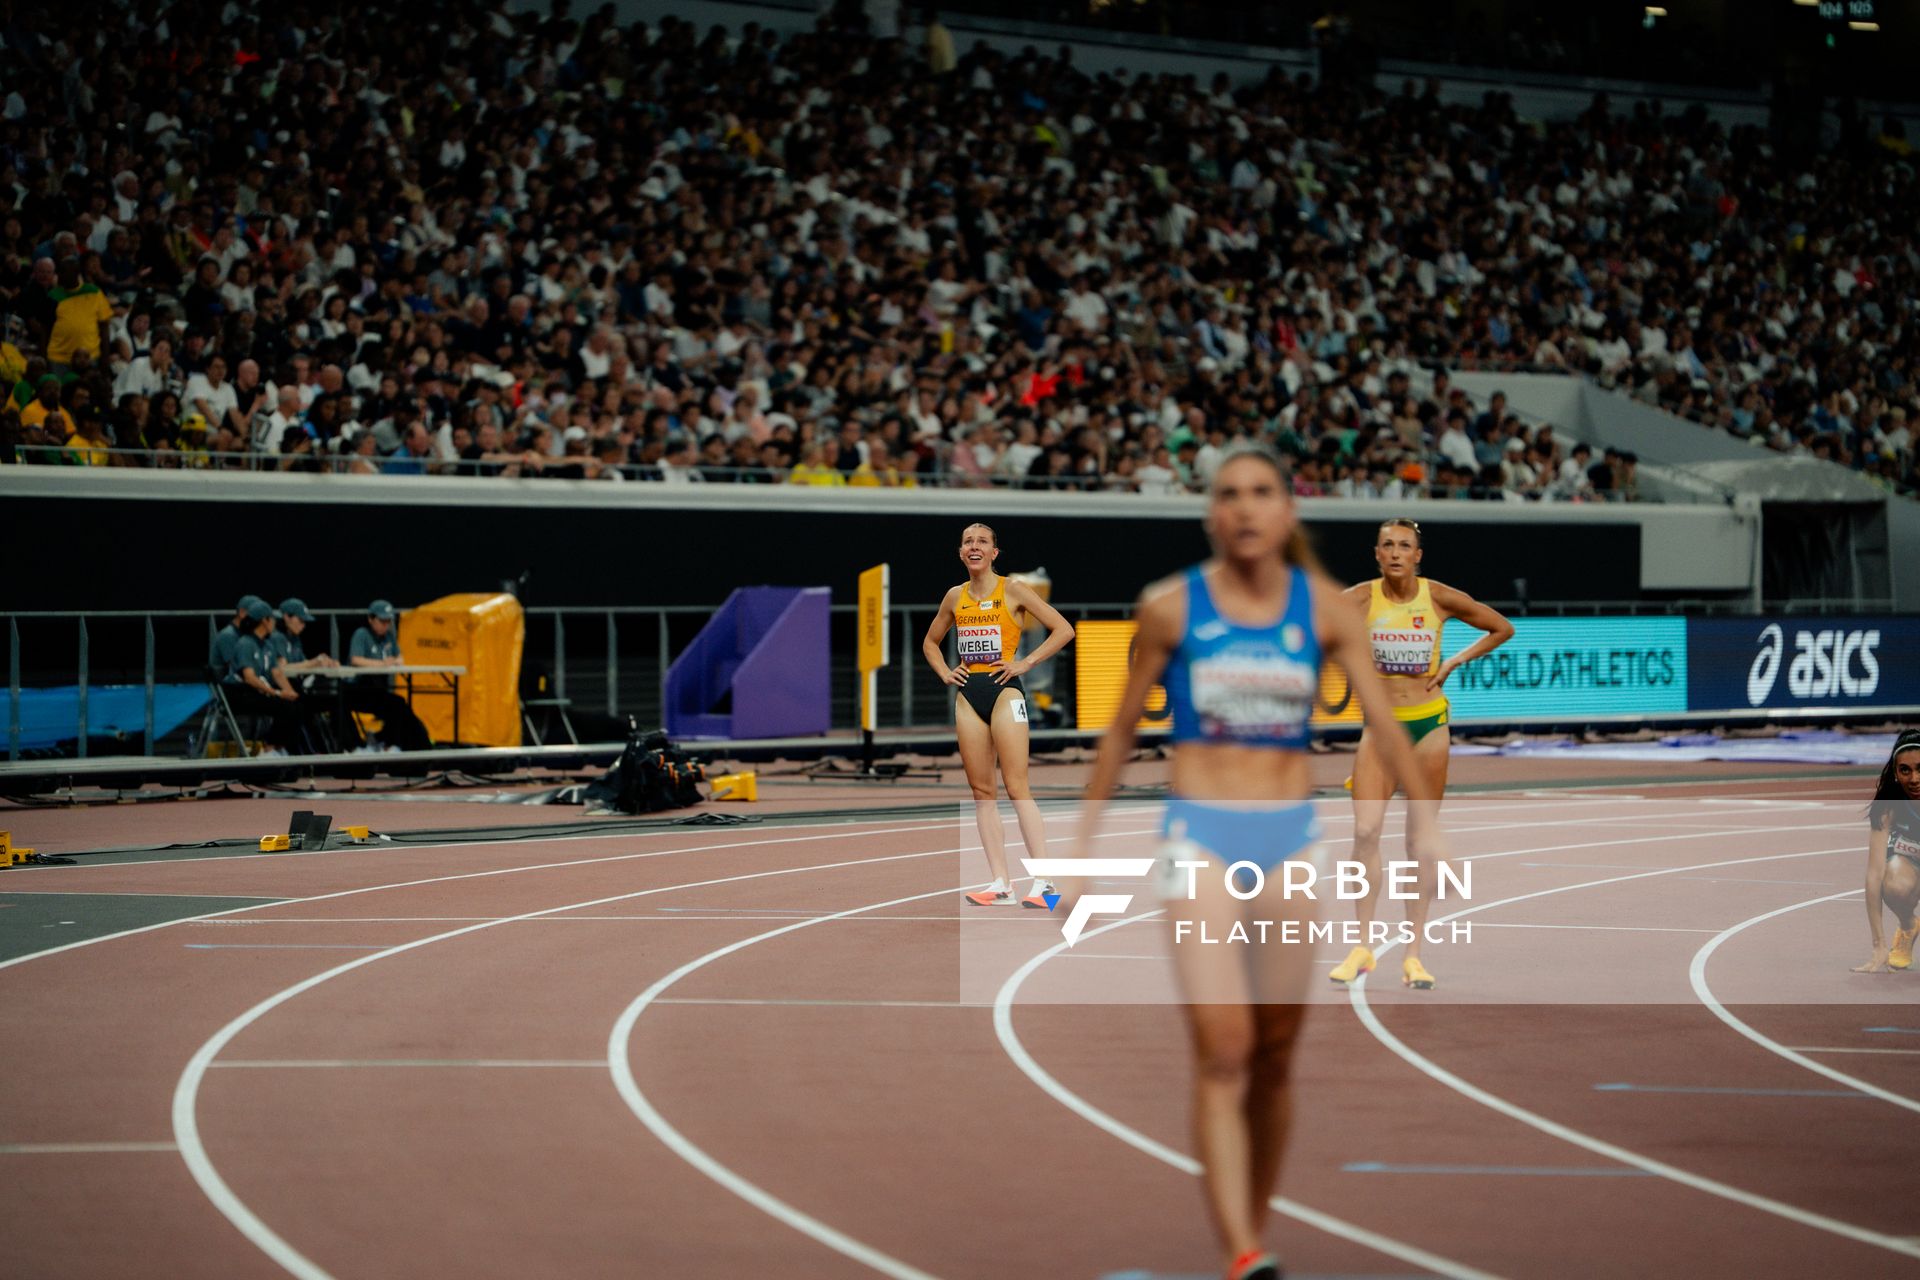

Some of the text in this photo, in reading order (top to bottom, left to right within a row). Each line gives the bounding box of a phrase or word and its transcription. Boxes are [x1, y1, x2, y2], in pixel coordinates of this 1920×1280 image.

[958, 614, 1000, 625] GERMANY
[958, 628, 999, 637] HONDA
[1372, 633, 1433, 642] HONDA
[1458, 648, 1674, 690] WORLD ATHLETICS
[1018, 703, 1026, 719] 4
